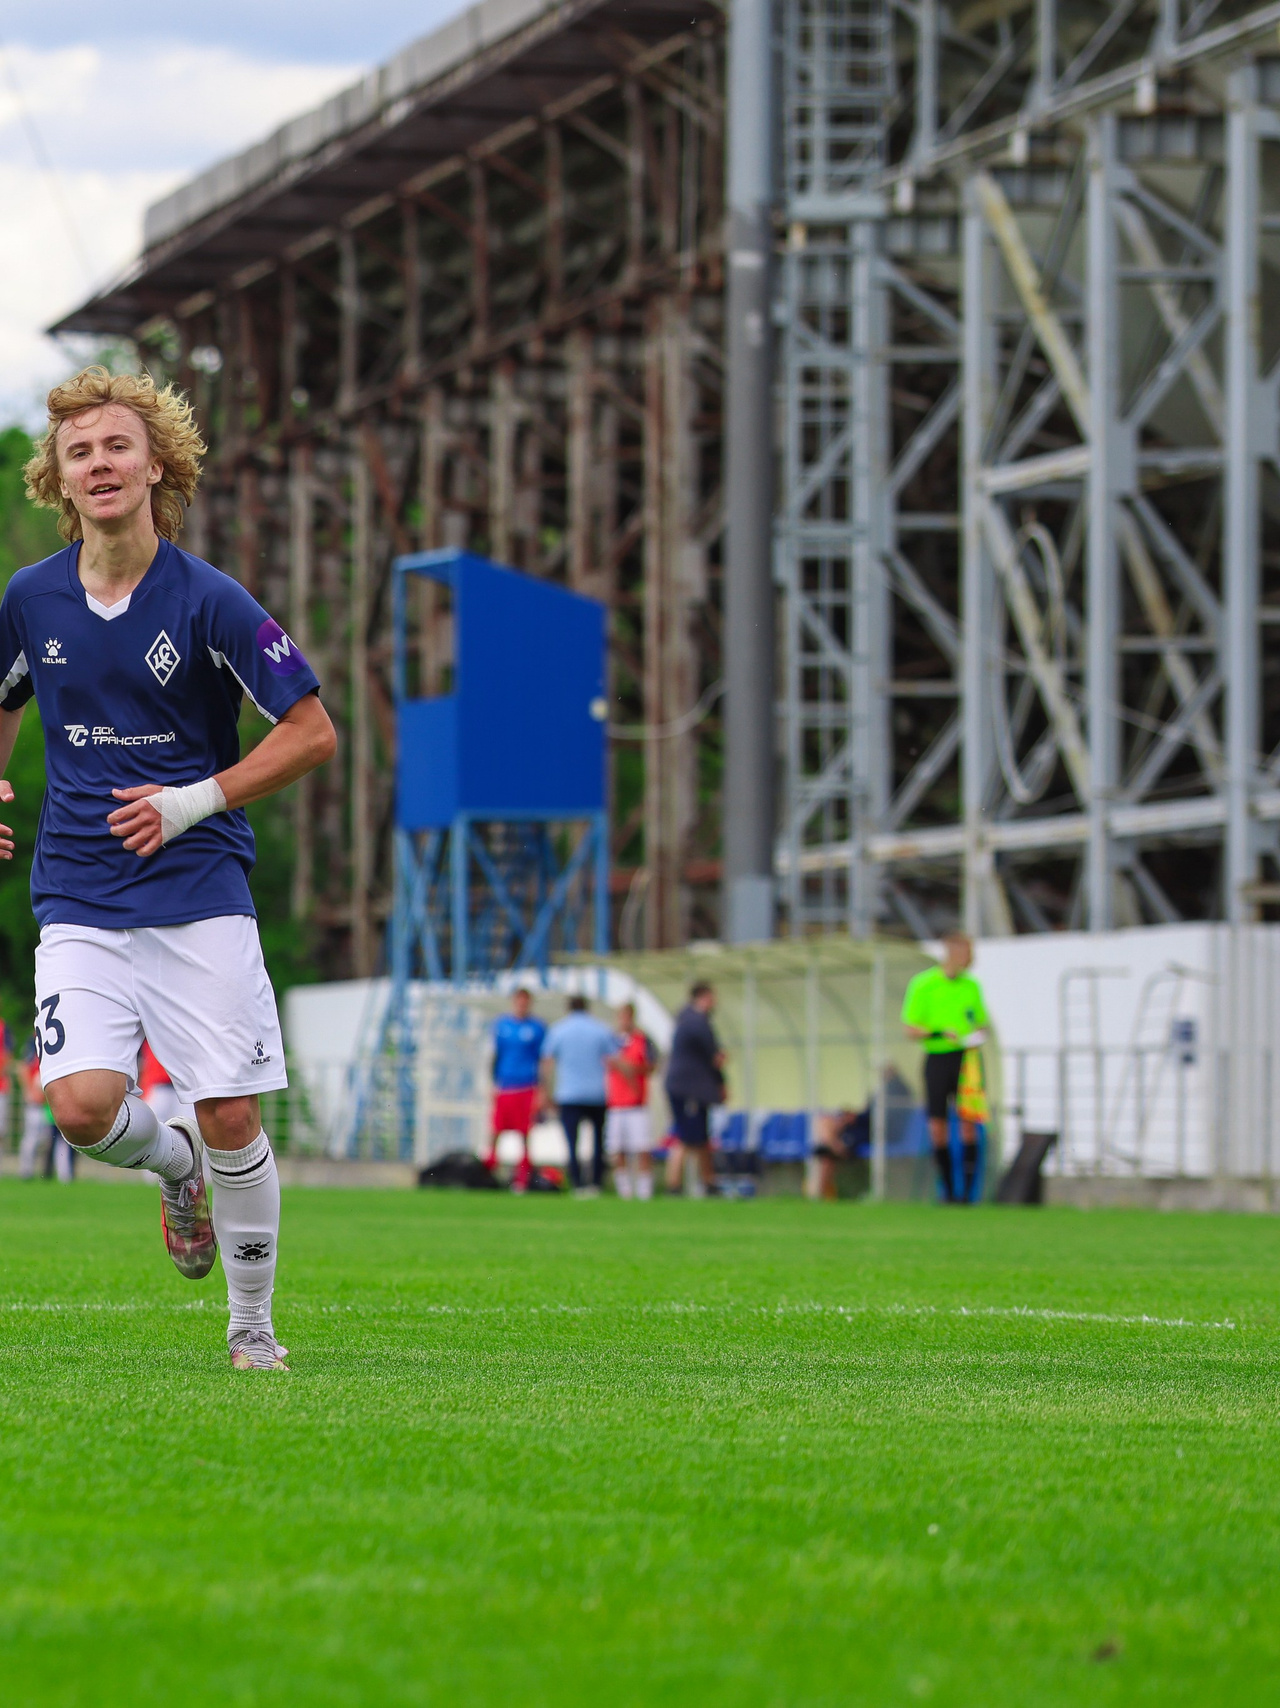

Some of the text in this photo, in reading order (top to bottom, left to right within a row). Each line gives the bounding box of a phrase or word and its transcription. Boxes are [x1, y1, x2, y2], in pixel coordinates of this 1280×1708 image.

[41, 656, 68, 665] KELME
[91, 726, 115, 736] ДСК
[91, 731, 176, 746] ТРАНССТРОЙ
[233, 1251, 270, 1262] KELME
